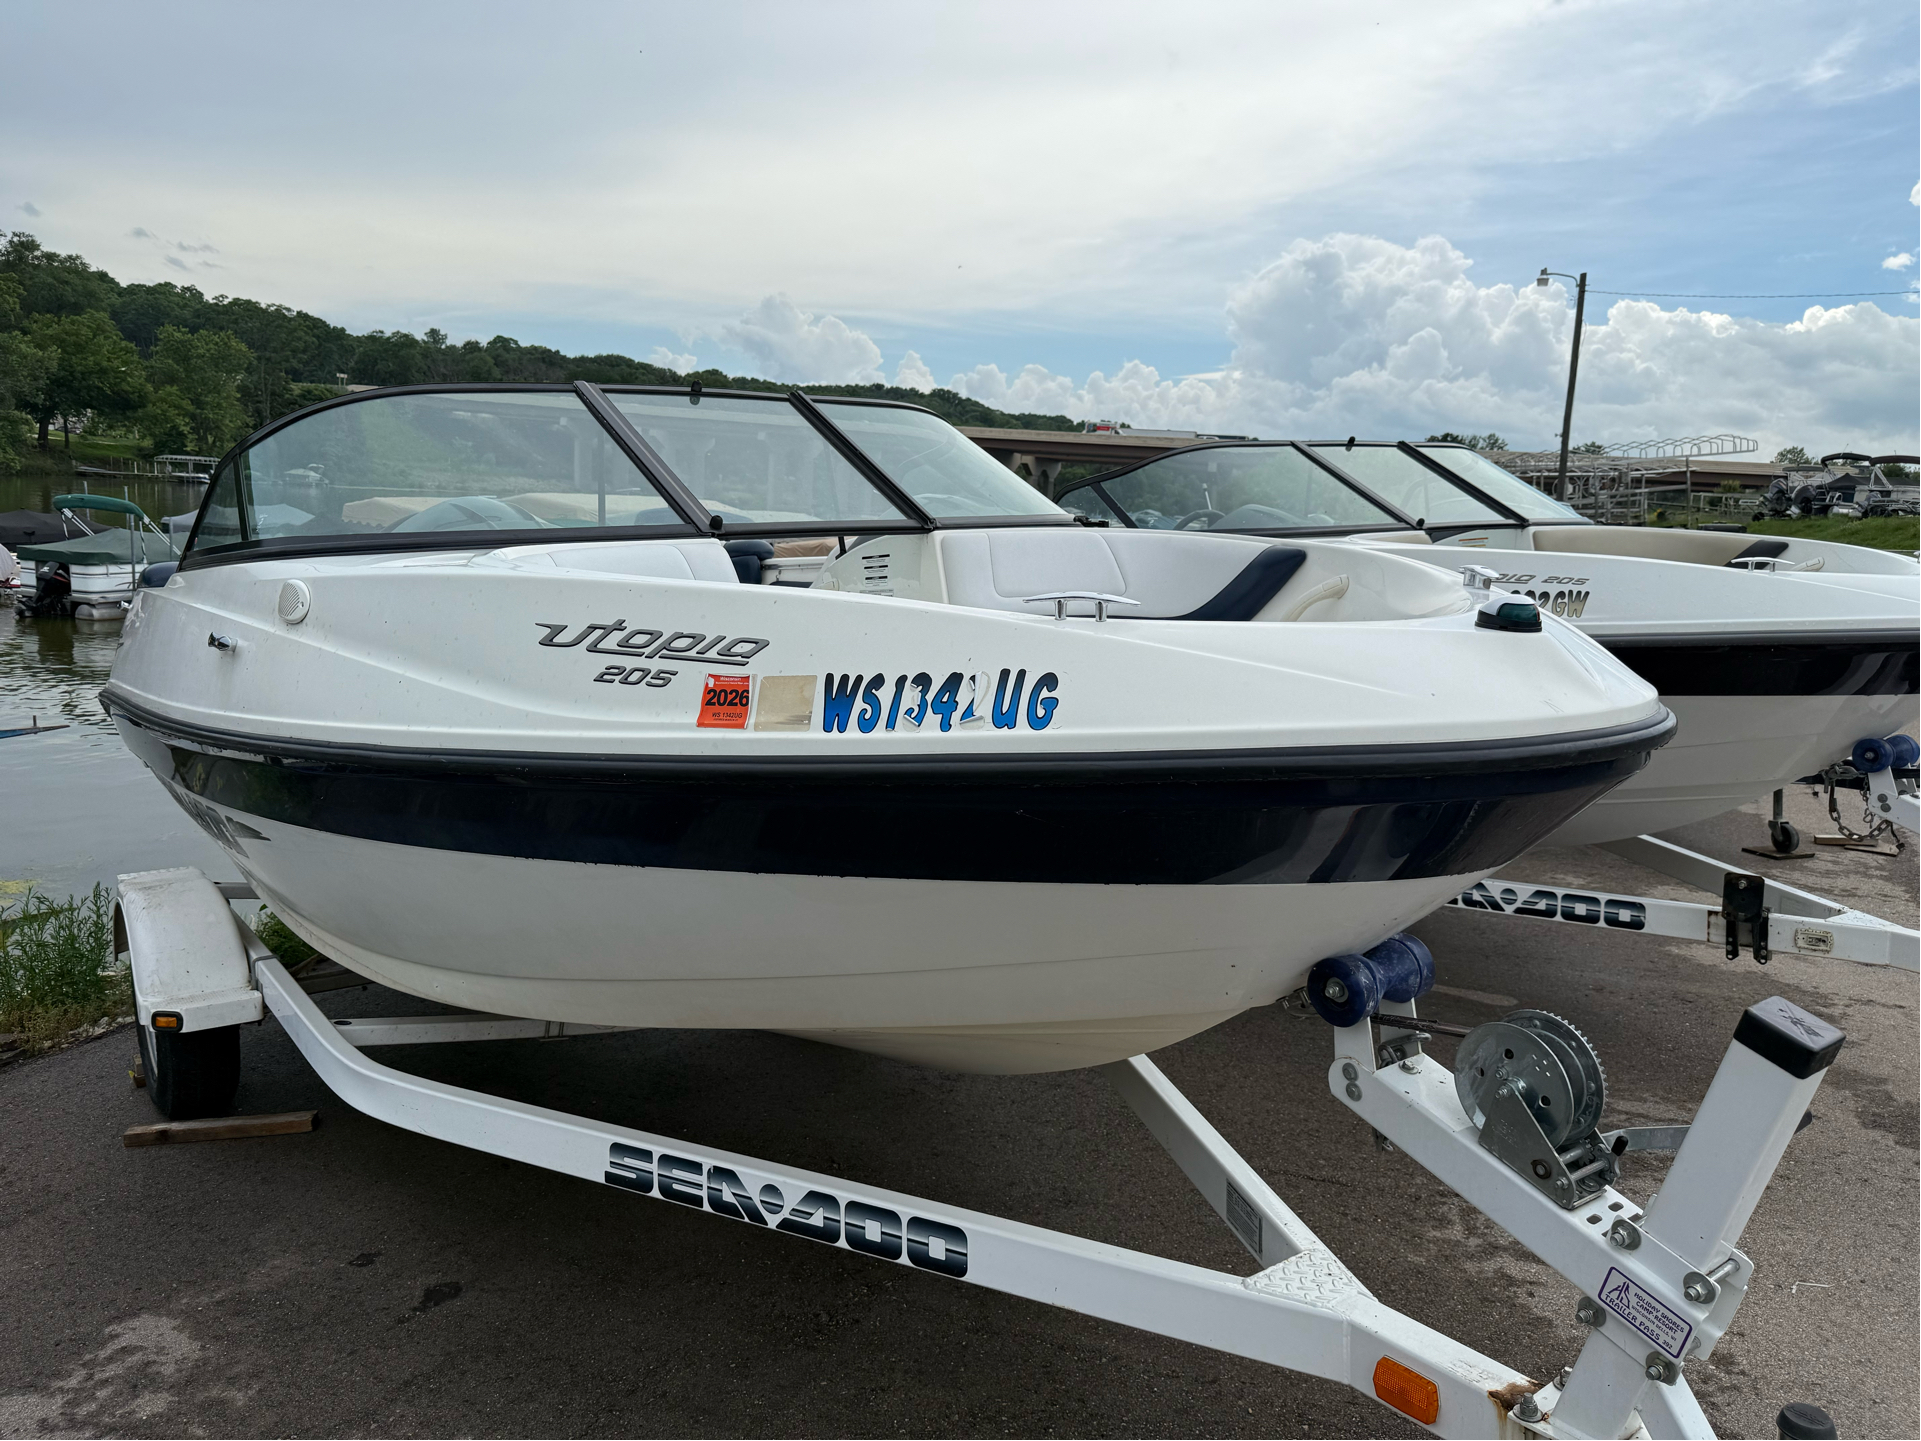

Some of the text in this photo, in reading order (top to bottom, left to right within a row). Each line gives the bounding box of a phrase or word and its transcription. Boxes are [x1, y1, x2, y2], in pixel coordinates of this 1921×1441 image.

[1541, 575, 1590, 586] 205
[1510, 589, 1590, 618] 2GW
[593, 664, 678, 688] 205
[705, 689, 749, 707] 2026
[1605, 1293, 1638, 1323] TRAILER
[1638, 1320, 1661, 1341] PASS
[1631, 1305, 1656, 1325] WISCONSIN
[1633, 1292, 1685, 1333] HOLIDAY SHORES
[1635, 1300, 1678, 1334] CAMP-RESORT
